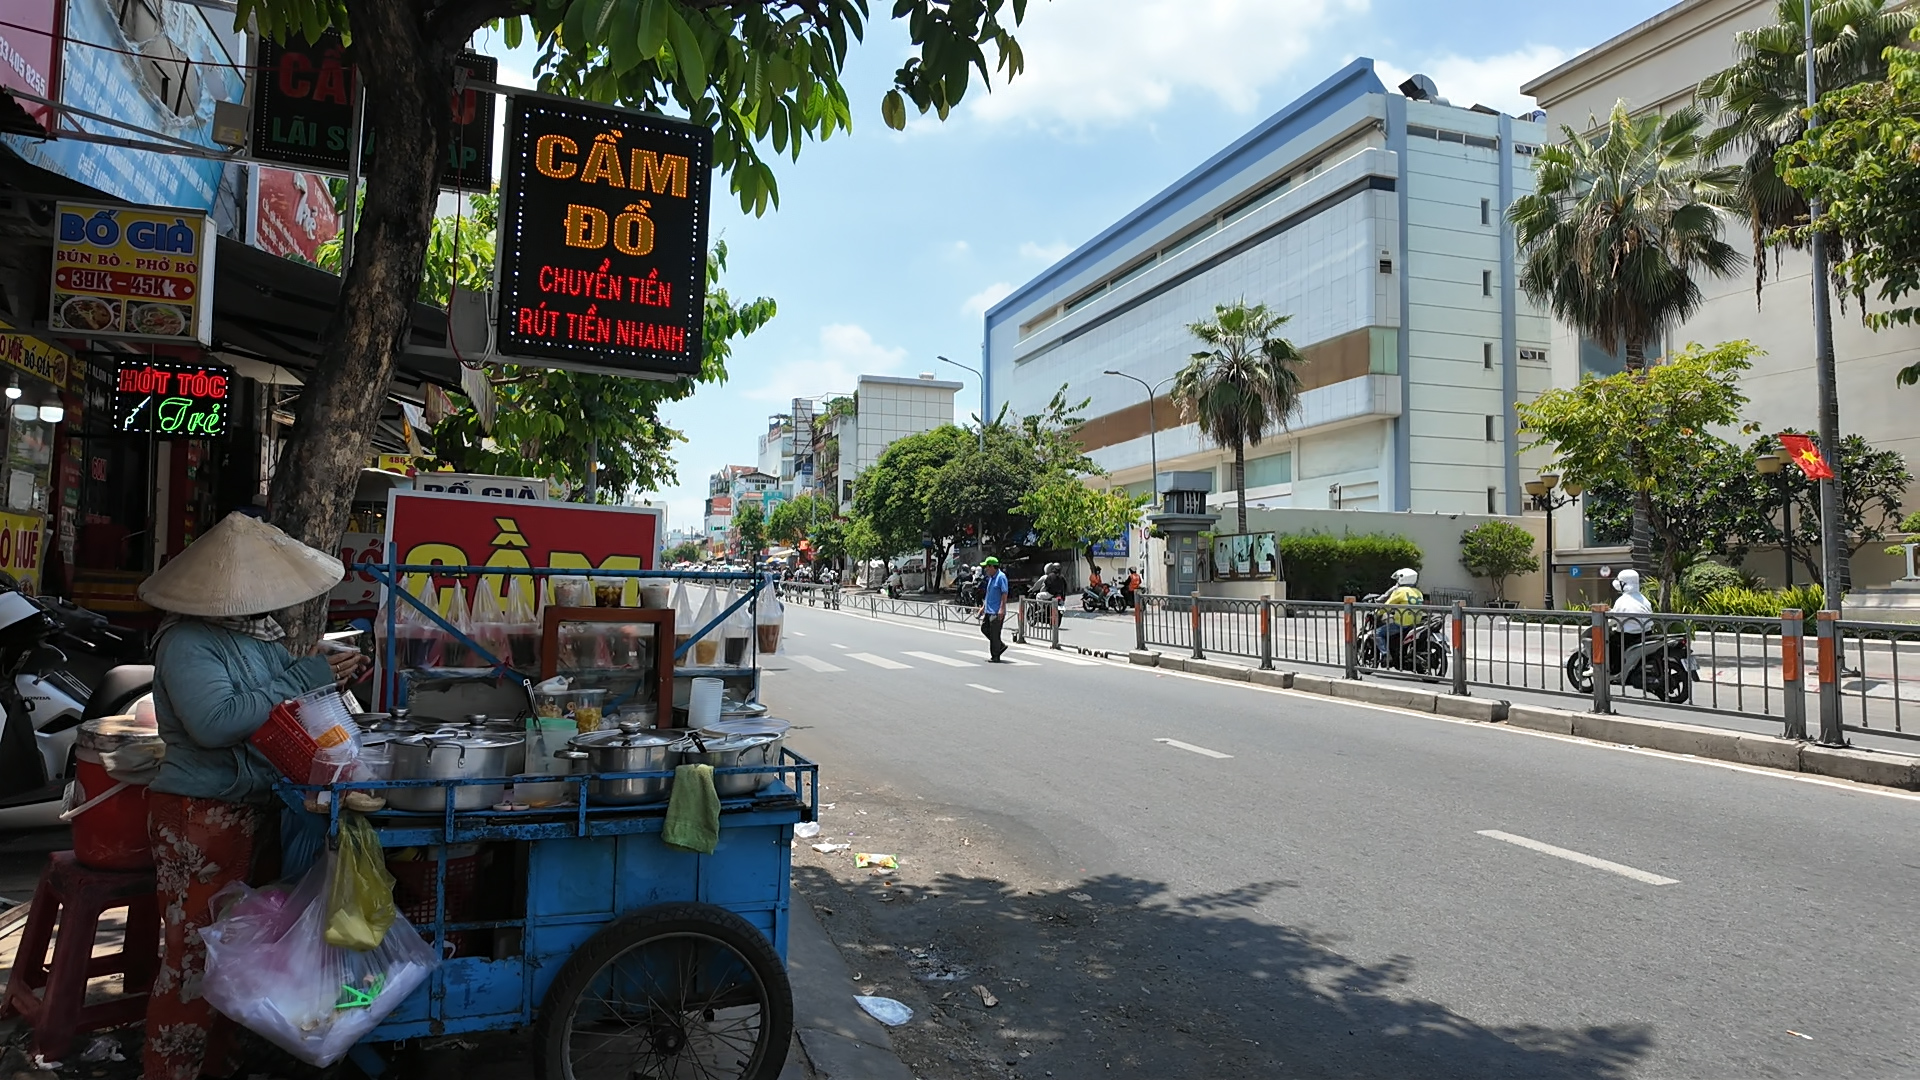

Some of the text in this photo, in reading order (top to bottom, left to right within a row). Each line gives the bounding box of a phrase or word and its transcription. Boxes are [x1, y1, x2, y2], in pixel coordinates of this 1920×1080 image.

[9, 48, 25, 78] 405
[25, 64, 46, 97] 8255
[279, 45, 355, 106] CẦ
[272, 115, 318, 147] LÃI
[536, 130, 689, 198] CẦM
[59, 209, 195, 254] BỐ GIÀ
[564, 200, 655, 257] ĐỒ
[57, 249, 92, 264] BÚN
[97, 253, 120, 267] BÒ
[136, 257, 170, 271] PHỞ
[175, 261, 198, 274] BÒ
[539, 258, 672, 308] CHUYỂN TIỀN
[519, 301, 686, 352] RÚT TIỀN NHANH
[119, 366, 170, 394] HỚT
[177, 371, 226, 399] TÓC
[158, 396, 221, 433] Trẻ
[0, 519, 40, 568] Ò HUẾ
